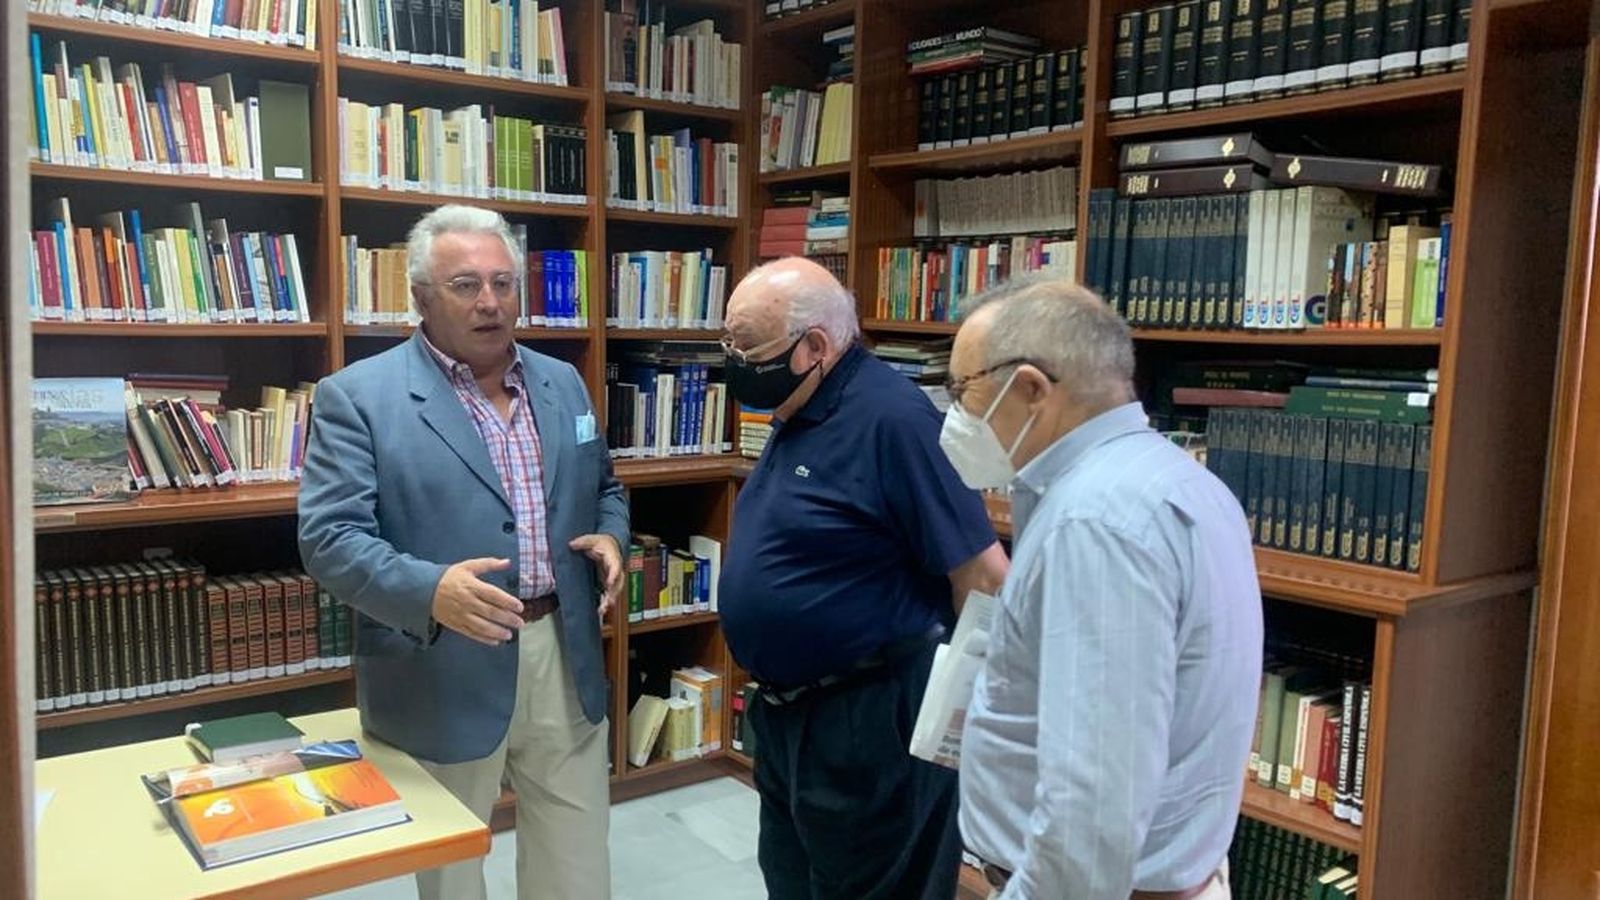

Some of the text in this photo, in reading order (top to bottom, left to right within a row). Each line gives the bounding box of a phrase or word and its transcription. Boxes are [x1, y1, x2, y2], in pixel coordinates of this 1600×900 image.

[955, 28, 982, 41] MUNDO
[1342, 727, 1351, 747] CIVIL
[1340, 748, 1349, 780] GUERRA
